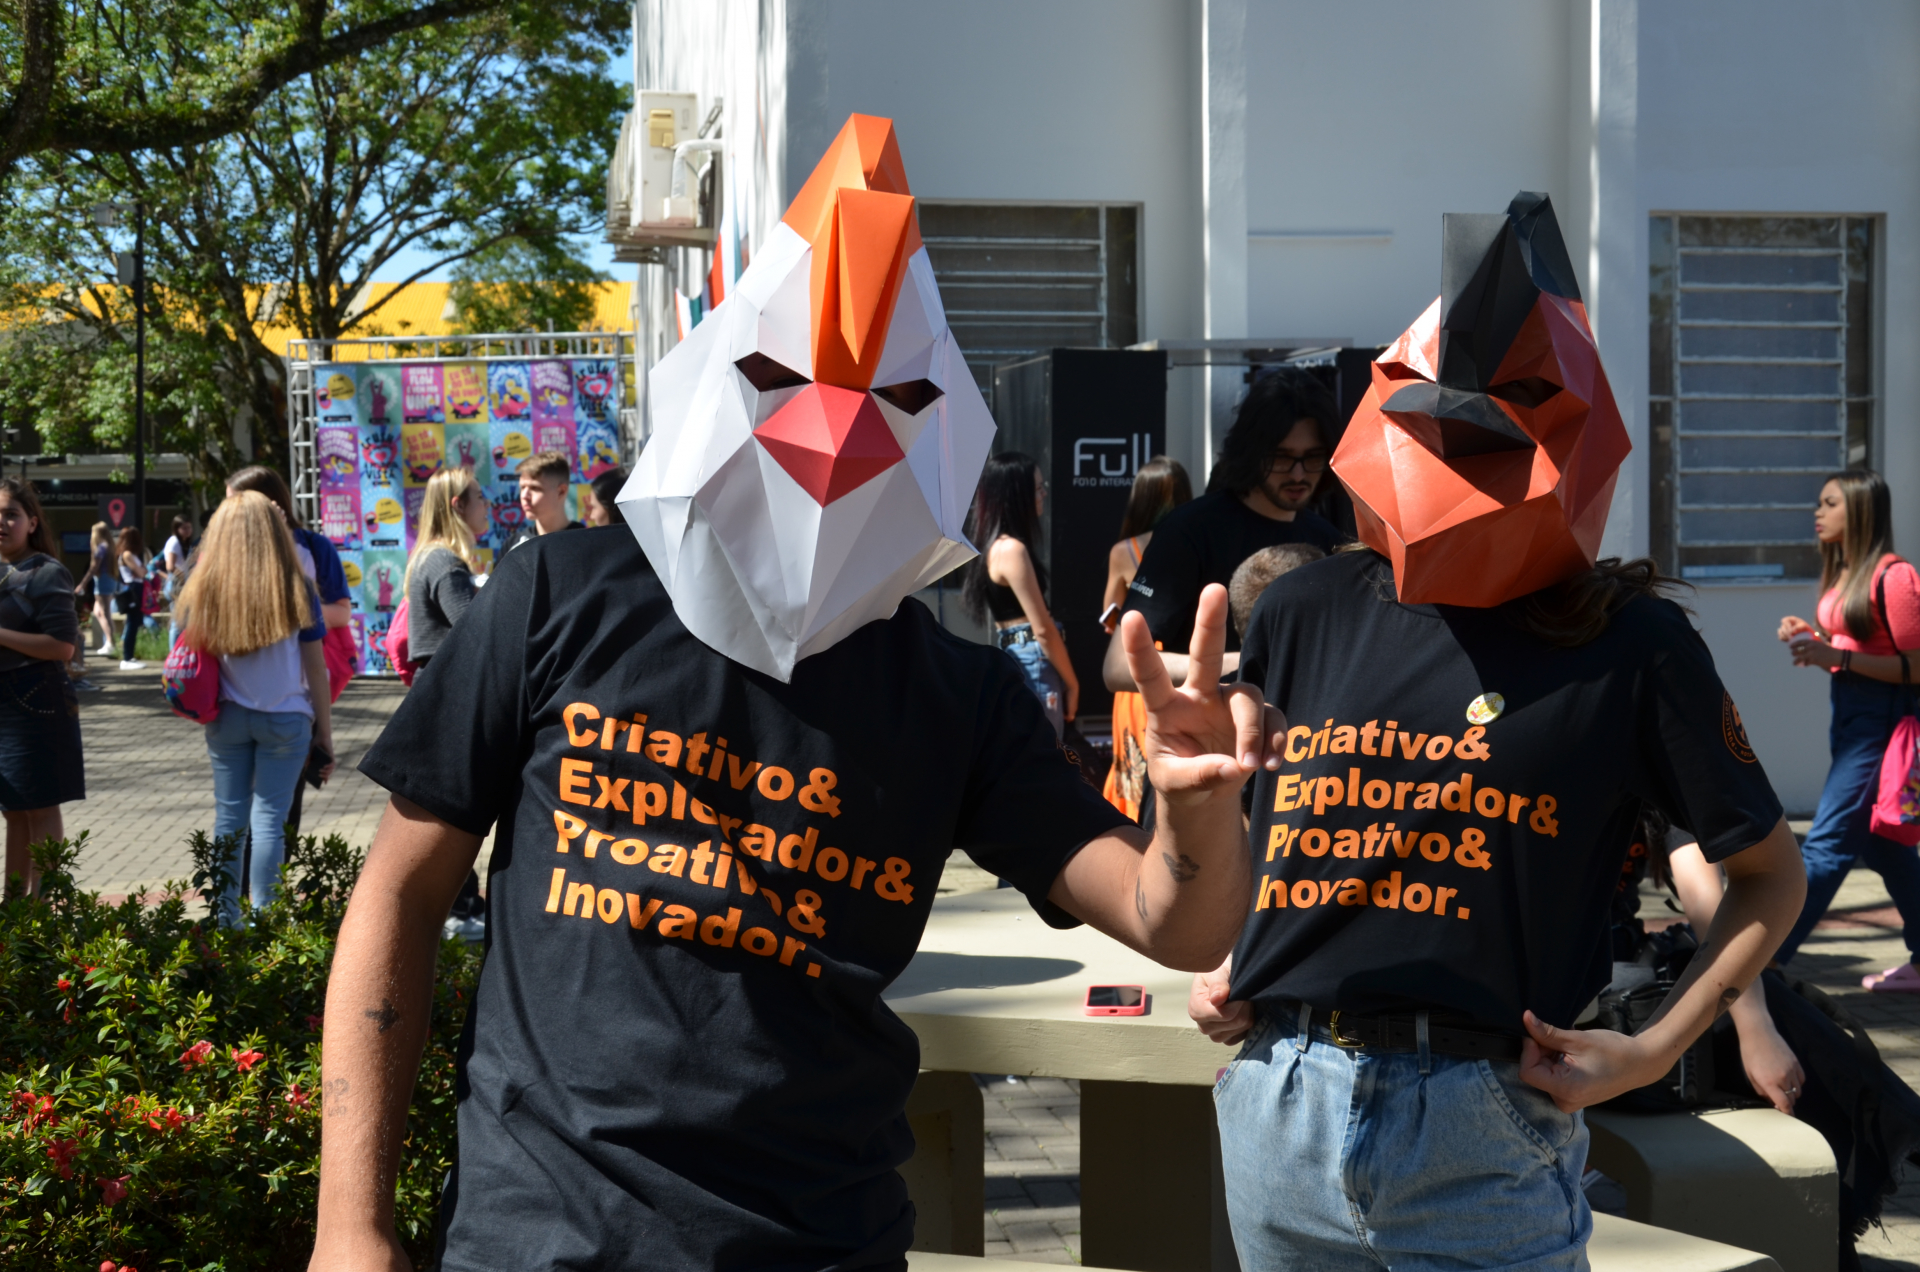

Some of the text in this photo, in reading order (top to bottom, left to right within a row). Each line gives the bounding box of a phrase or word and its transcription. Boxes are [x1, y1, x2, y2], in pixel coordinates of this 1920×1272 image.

[1073, 433, 1151, 476] Full
[562, 701, 842, 818] Criativo&
[1284, 718, 1492, 763] Criativo&
[558, 757, 915, 906] Explorador&
[1273, 767, 1560, 839] Explorador&
[553, 810, 827, 939] Proativo&
[1265, 822, 1493, 871] Proativo&
[545, 867, 822, 979] Inovador.
[1255, 870, 1471, 921] Inovador.
